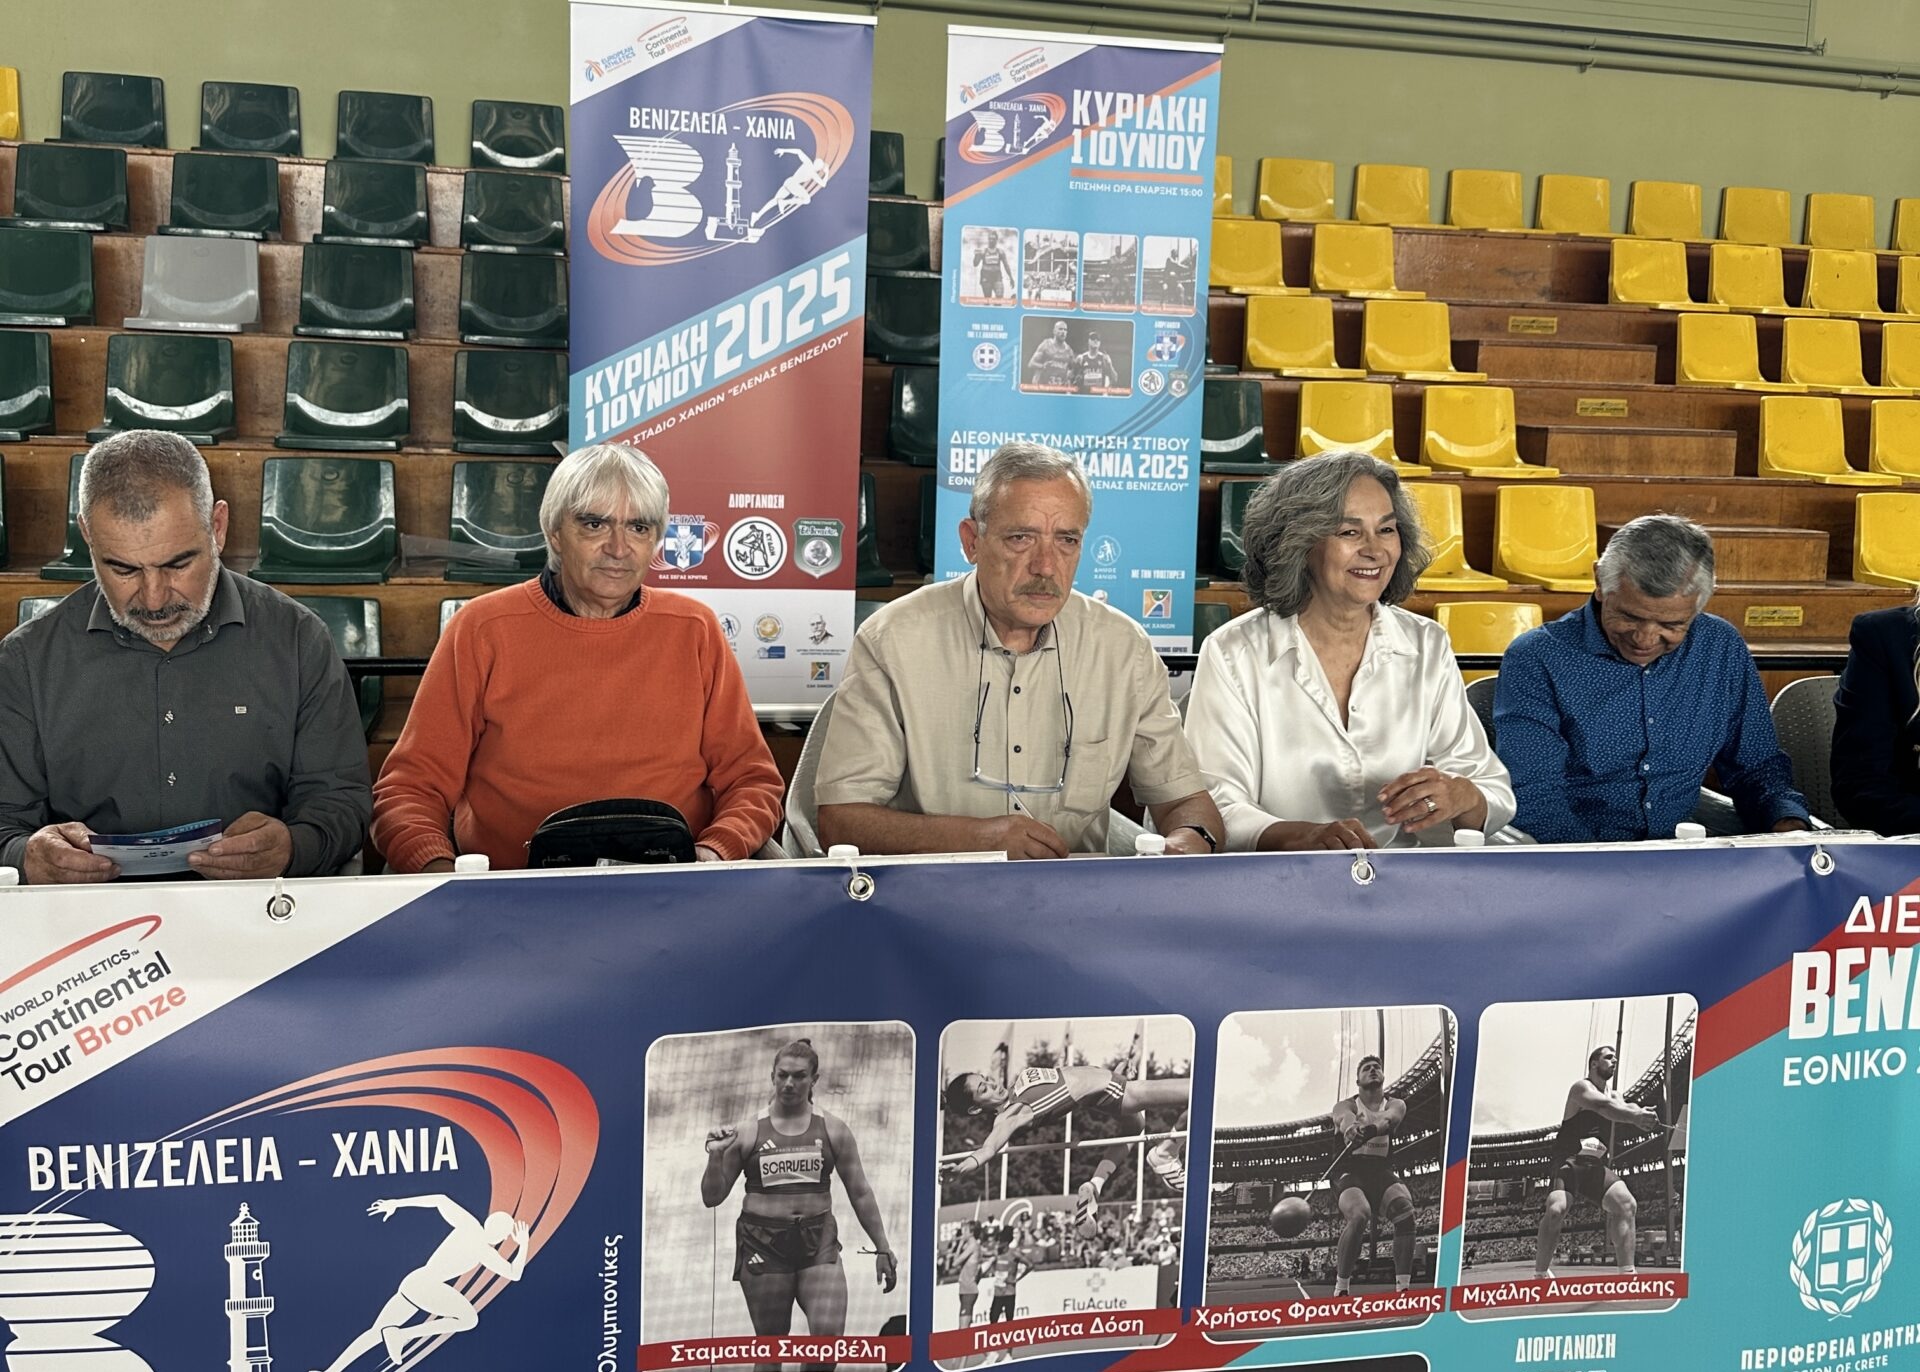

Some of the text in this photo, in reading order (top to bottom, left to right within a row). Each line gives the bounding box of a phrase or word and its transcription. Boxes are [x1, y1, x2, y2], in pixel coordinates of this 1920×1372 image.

[645, 26, 688, 52] Continental
[648, 47, 666, 59] Tour
[629, 106, 728, 135] ΒΕΝΙΖΕΛΕΙΑ
[746, 116, 796, 140] ΧΑΝΙΑ
[1072, 89, 1207, 133] ΚΥΡΙΑΚΗ
[1071, 128, 1206, 171] 1 ΙΟΥΝΙΟΥ
[1069, 181, 1203, 197] ΕΠΙΣΗΜΗ ΩΡΑ ΕΝΑΡΞΗΣ 15:00
[714, 251, 851, 380] 2025
[585, 320, 709, 409] ΚΥΡΙΑΚΗ
[585, 354, 708, 442] 1 ΙΟΥΝΙΟΥ
[633, 417, 676, 445] ΣΤΑΔΙΟ
[679, 393, 725, 423] ΧΑΝΙΩΝ
[950, 431, 1190, 451] ΔΙΕΘΝΗΣ ΣΥΝΑΝΤΗΣΗ ΣΤΙΒΟΥ
[950, 447, 992, 474] ΒΕΝ
[1138, 454, 1189, 479] 2025
[948, 475, 976, 486] ΕΘΝΙ
[1090, 480, 1124, 490] ΛΕΝΑΣ
[728, 493, 785, 509] ΔΙΟΡΓΑΝΩΣΗ
[669, 514, 705, 525] ΕΓΑΣ
[0, 950, 172, 1062] Continental
[1, 990, 54, 1024] WORLD
[1788, 947, 1920, 1040] ΒΕΝ
[1, 986, 187, 1091] Tour Bronze
[1783, 1046, 1907, 1087] ΕΘΝΙΚΟ
[27, 1136, 283, 1192] ΒΕΝΙΖΕΛΕΙΑ
[331, 1126, 459, 1178] ΧΑΝΙΑ
[1063, 1298, 1127, 1312] FluAcute
[1462, 1276, 1675, 1306] Μιχάλης Αναστασάκης
[1195, 1291, 1442, 1329] Χρήστος Φραντζεσκάκης
[974, 1316, 1144, 1349] Παναγιώτα Δόση
[1515, 1334, 1616, 1363] ΔΙΟΡΓΑΝΩΣΗ
[671, 1339, 887, 1363] Σταματία Σκαρβέλη
[1741, 1336, 1856, 1370] ΠΕΡΙΦΕΡΕΙΑ
[1854, 1355, 1889, 1371] CRETE
